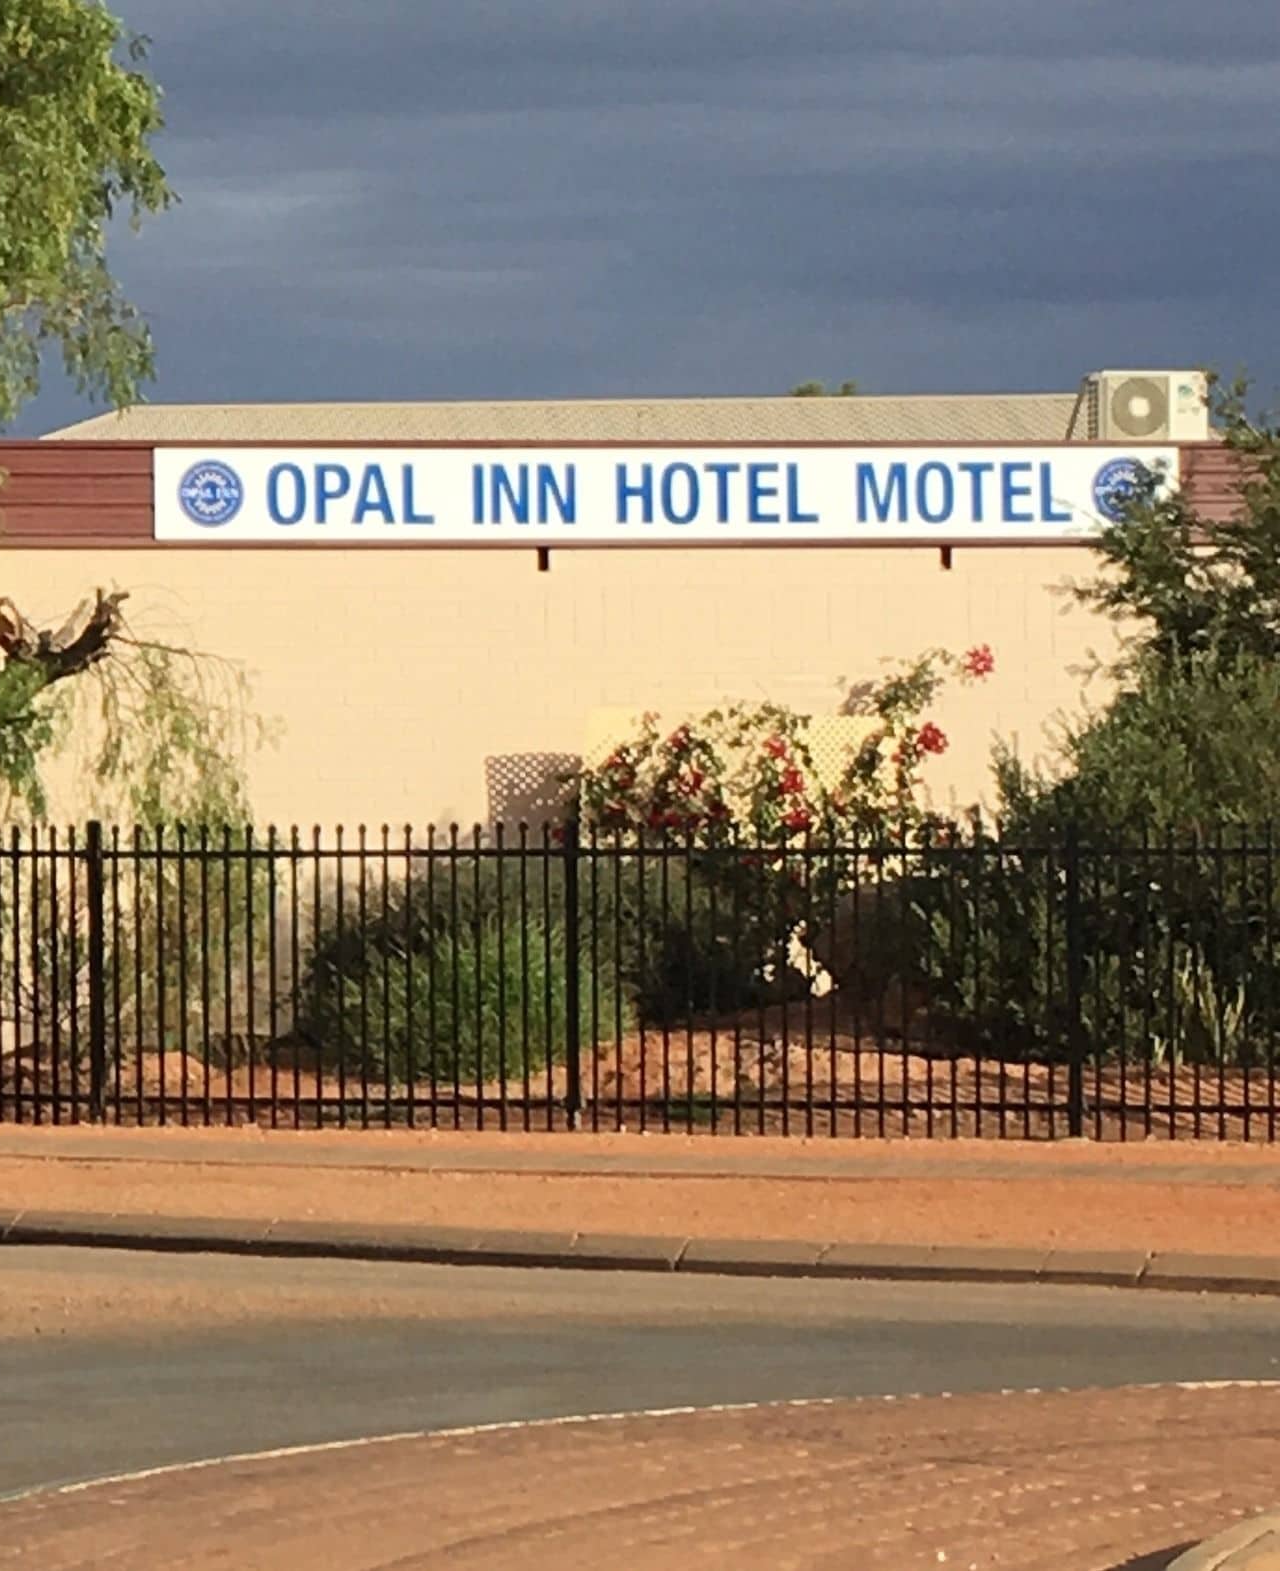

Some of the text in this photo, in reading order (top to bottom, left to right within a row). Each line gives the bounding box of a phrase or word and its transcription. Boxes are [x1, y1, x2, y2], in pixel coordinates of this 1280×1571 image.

[267, 461, 1073, 525] OPAL INN HOTEL MOTEL
